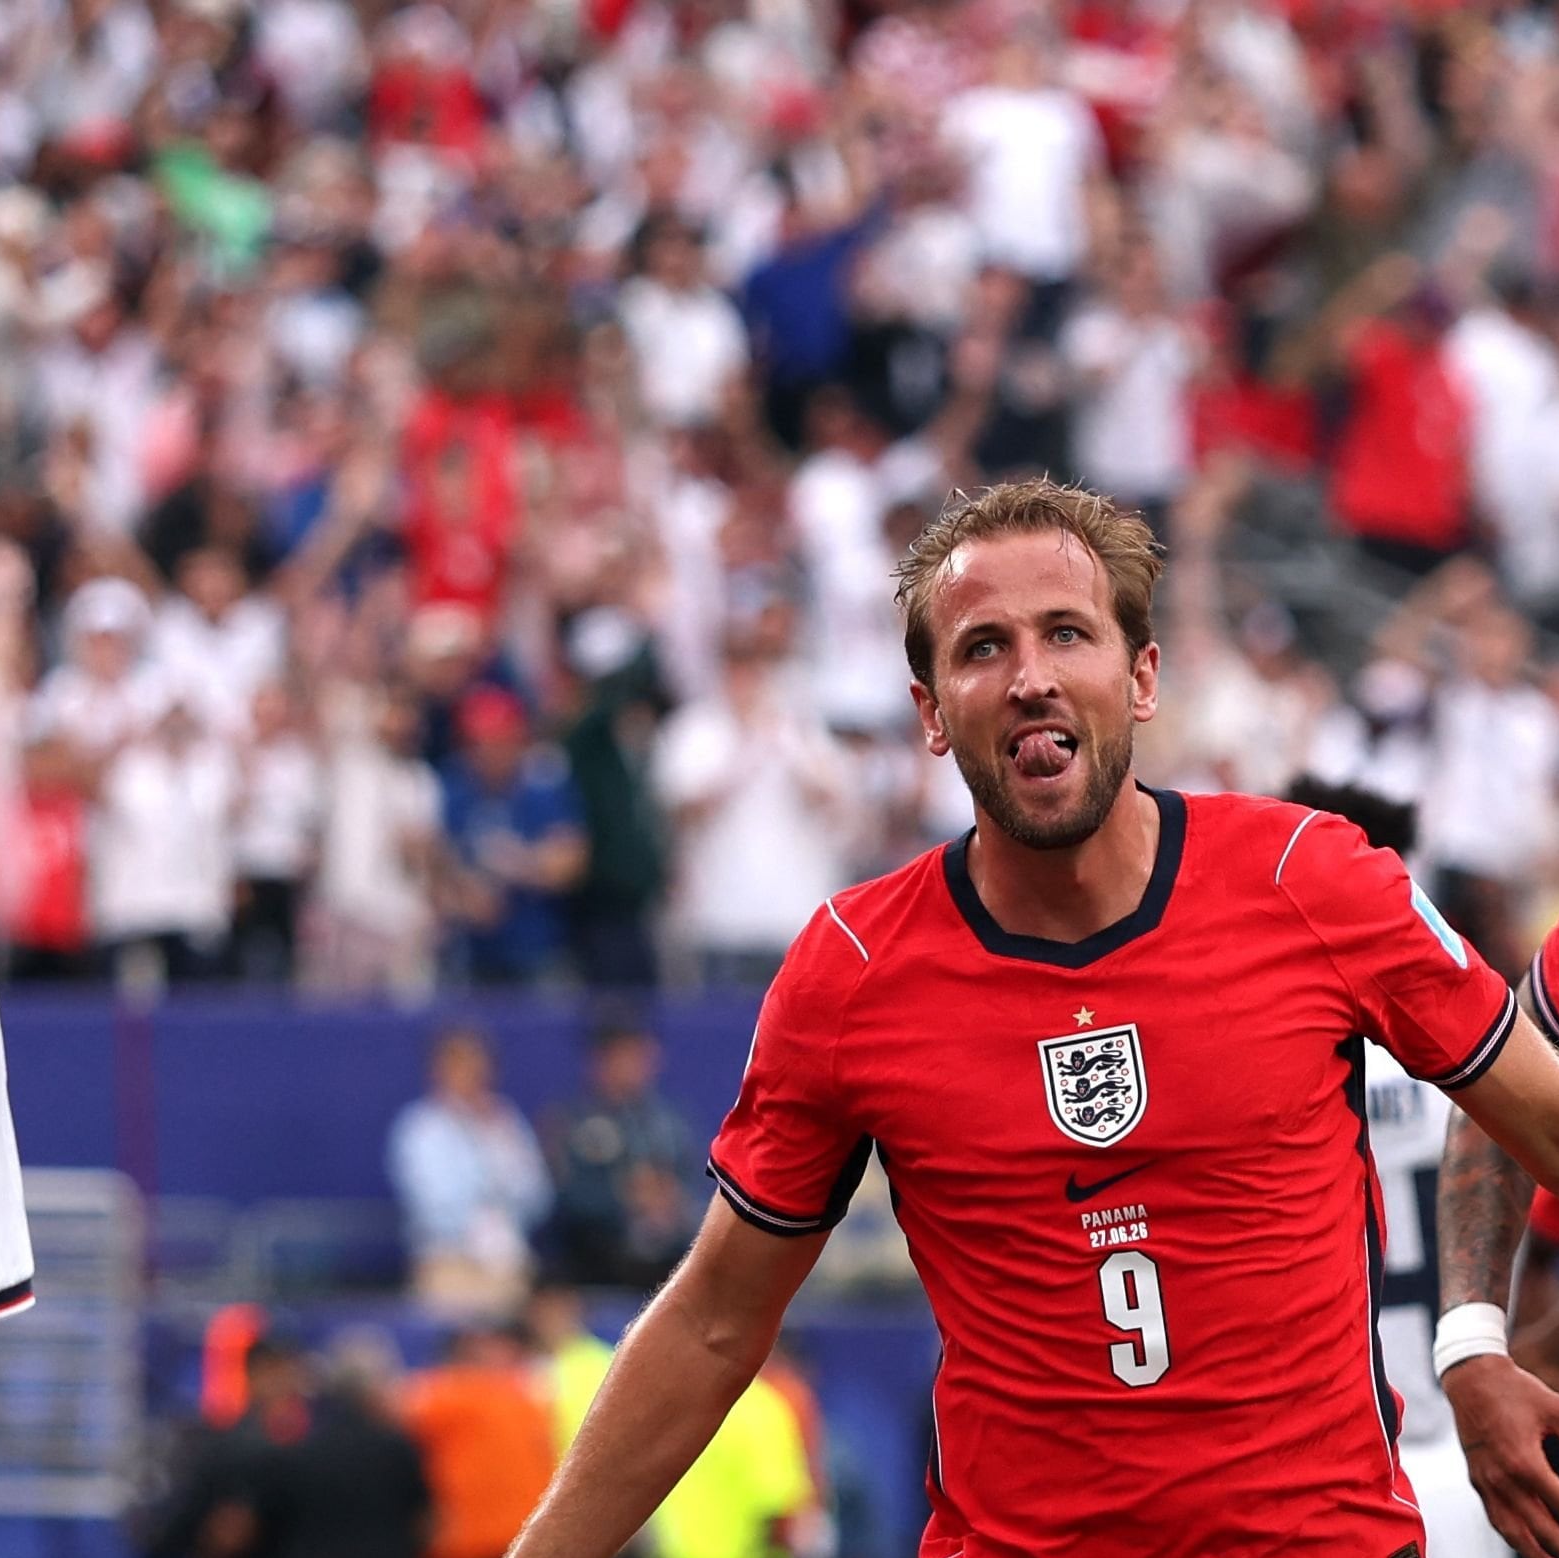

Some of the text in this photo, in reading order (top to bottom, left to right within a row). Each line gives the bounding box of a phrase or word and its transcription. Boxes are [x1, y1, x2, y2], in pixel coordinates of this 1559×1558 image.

[1081, 1204, 1148, 1230] PANAMA
[1089, 1222, 1148, 1248] 27.06.26
[1099, 1251, 1170, 1387] 9
